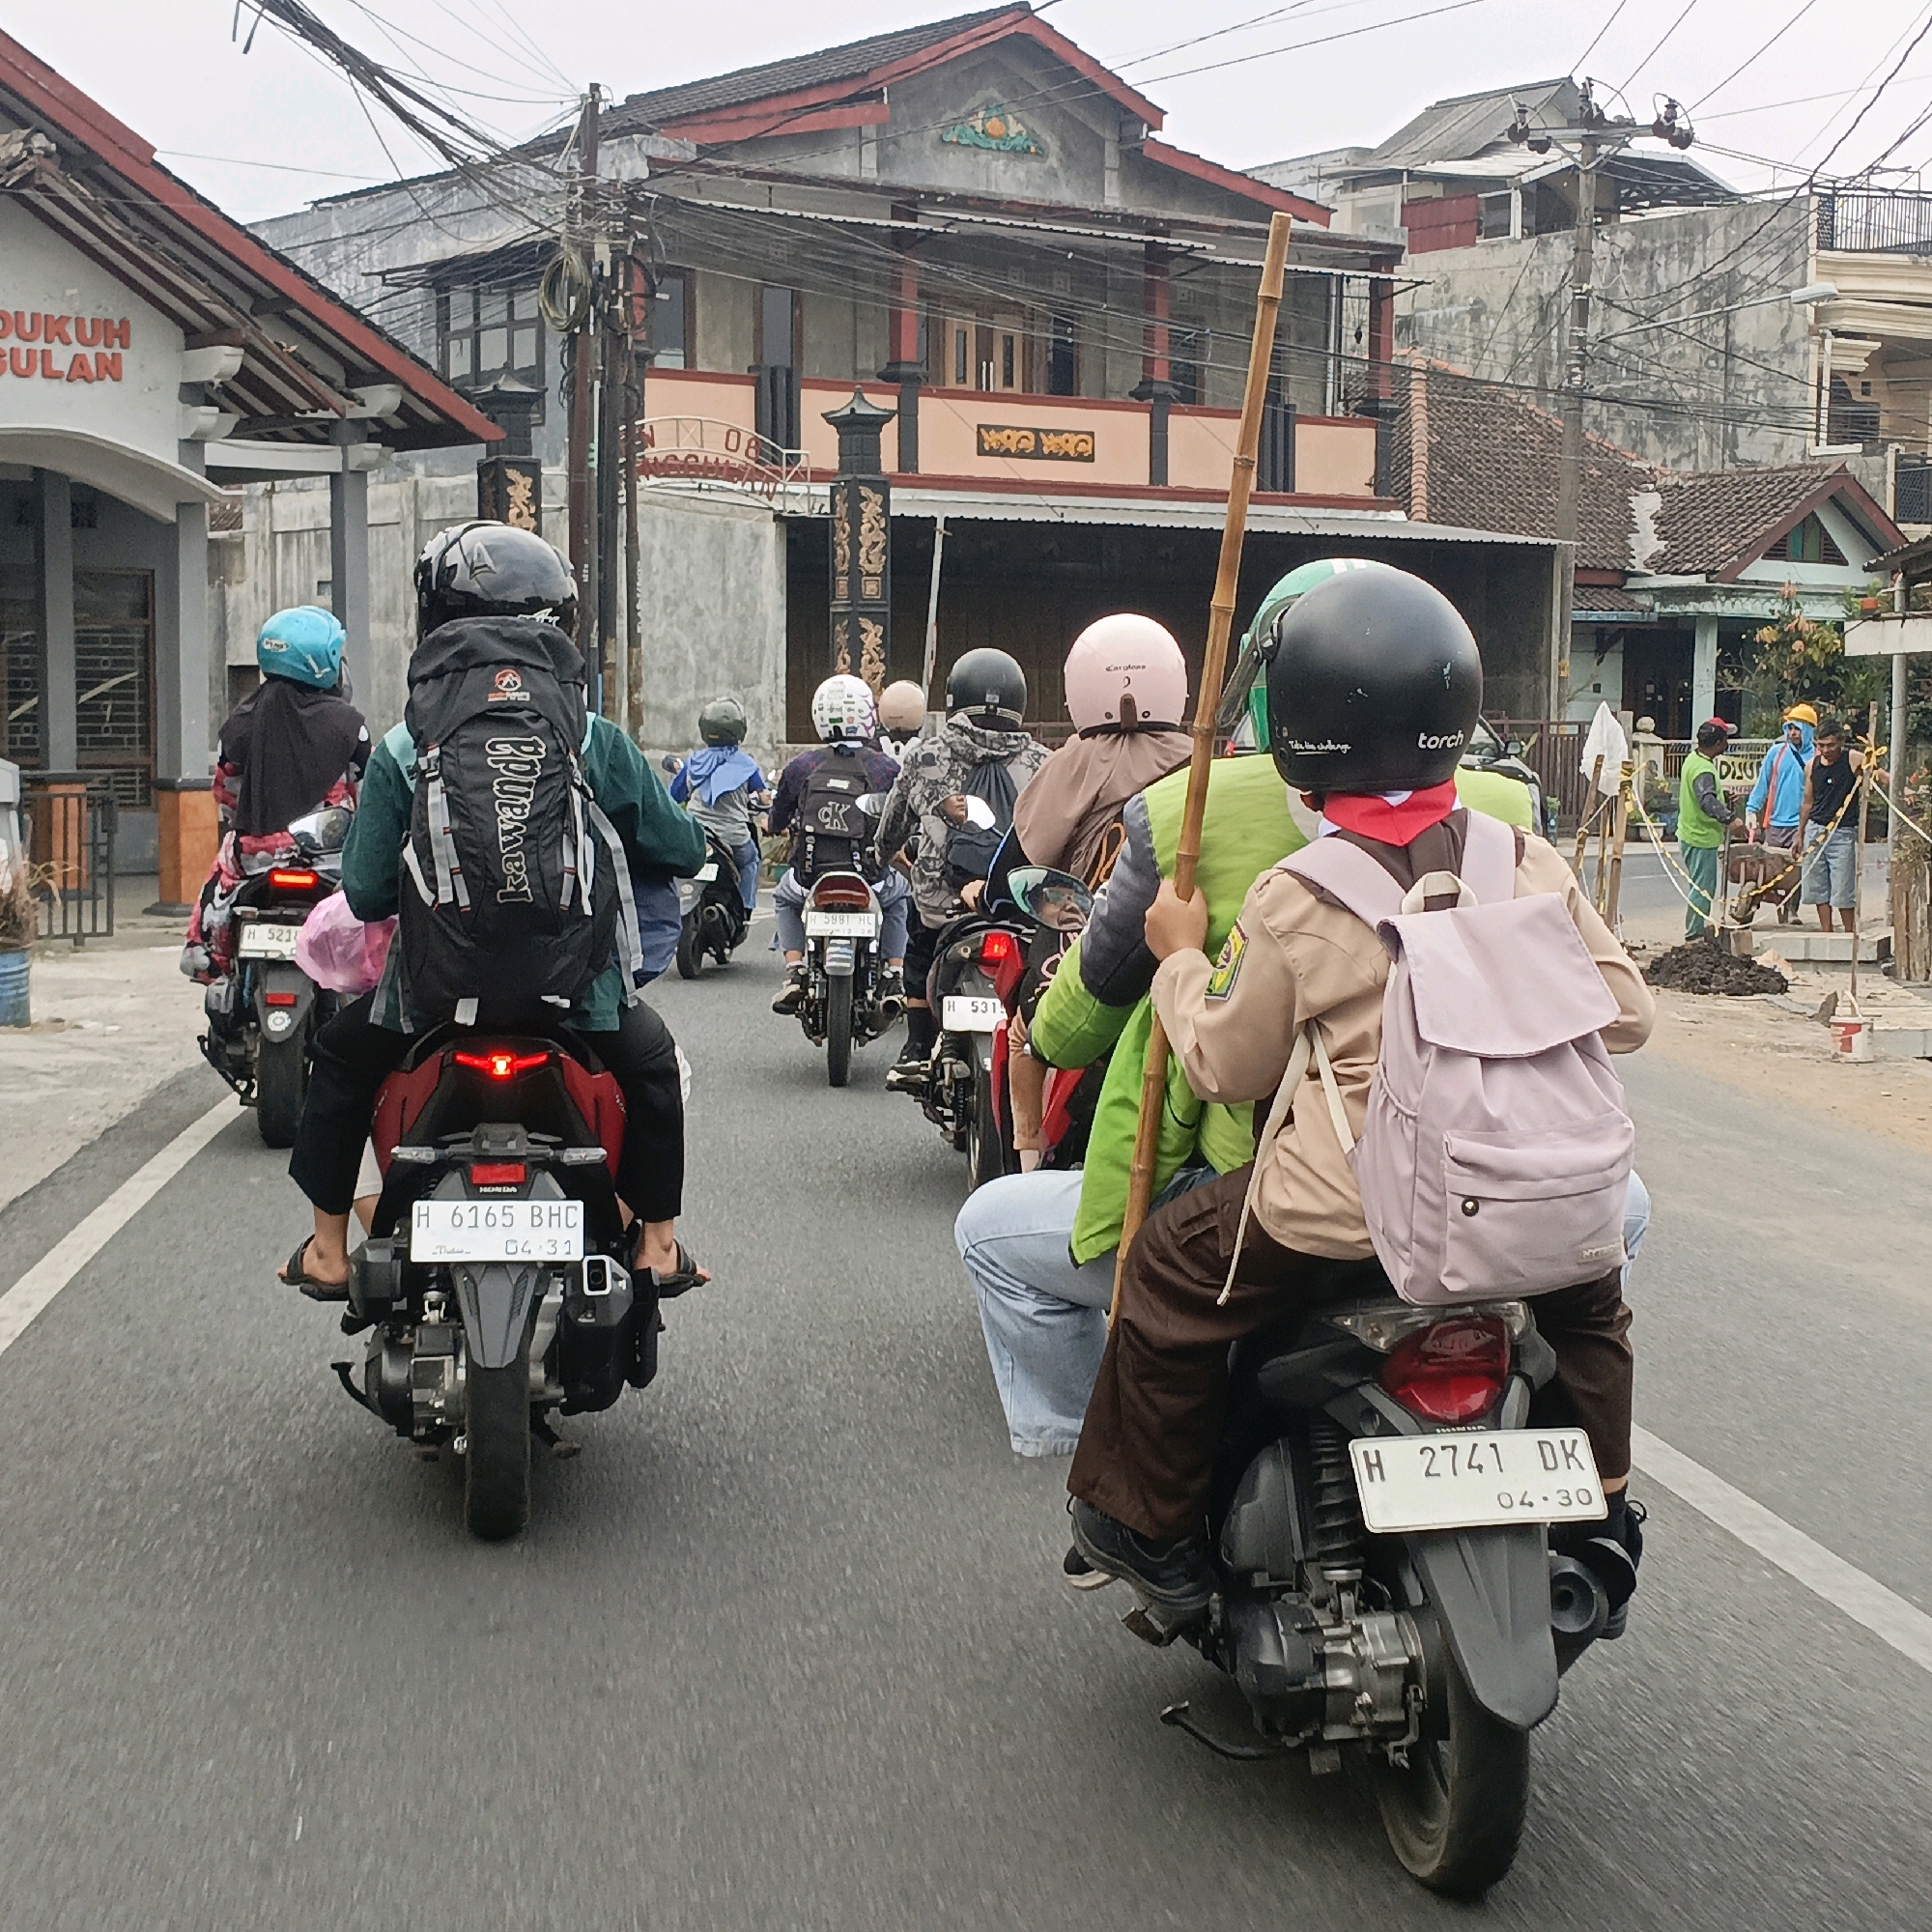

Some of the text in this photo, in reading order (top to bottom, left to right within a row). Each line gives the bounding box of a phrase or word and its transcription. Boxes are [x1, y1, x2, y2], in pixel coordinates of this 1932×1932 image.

[0, 347, 123, 384] ULAN
[725, 429, 761, 462] 08
[1417, 729, 1464, 750] torch
[485, 735, 547, 903] kawanda
[247, 928, 256, 940] H
[948, 1000, 955, 1012] H
[416, 1205, 578, 1229] H 6165 BHC
[1362, 1437, 1586, 1483] H 2741 DK
